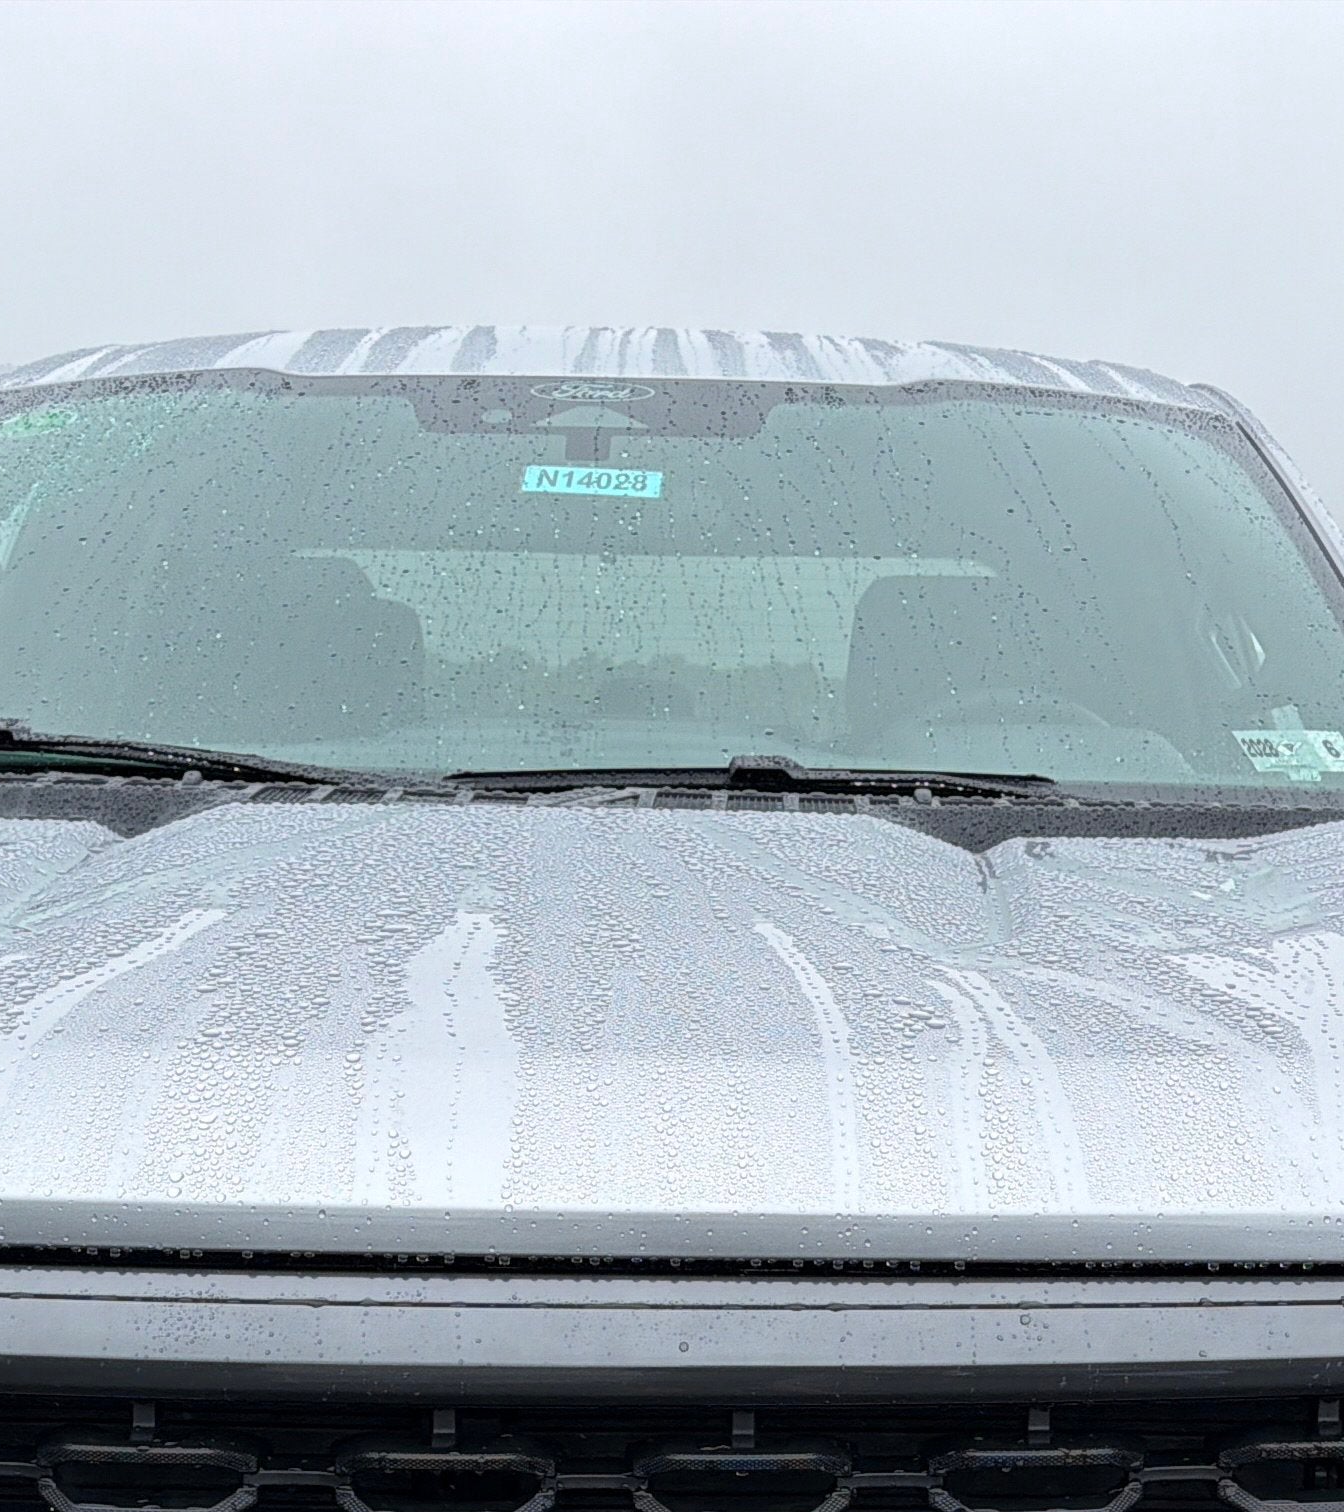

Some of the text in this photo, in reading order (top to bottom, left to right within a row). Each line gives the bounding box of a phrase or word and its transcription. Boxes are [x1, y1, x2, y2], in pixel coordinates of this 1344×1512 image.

[551, 382, 633, 399] Ford
[536, 468, 648, 492] N14028
[1322, 739, 1341, 758] 6
